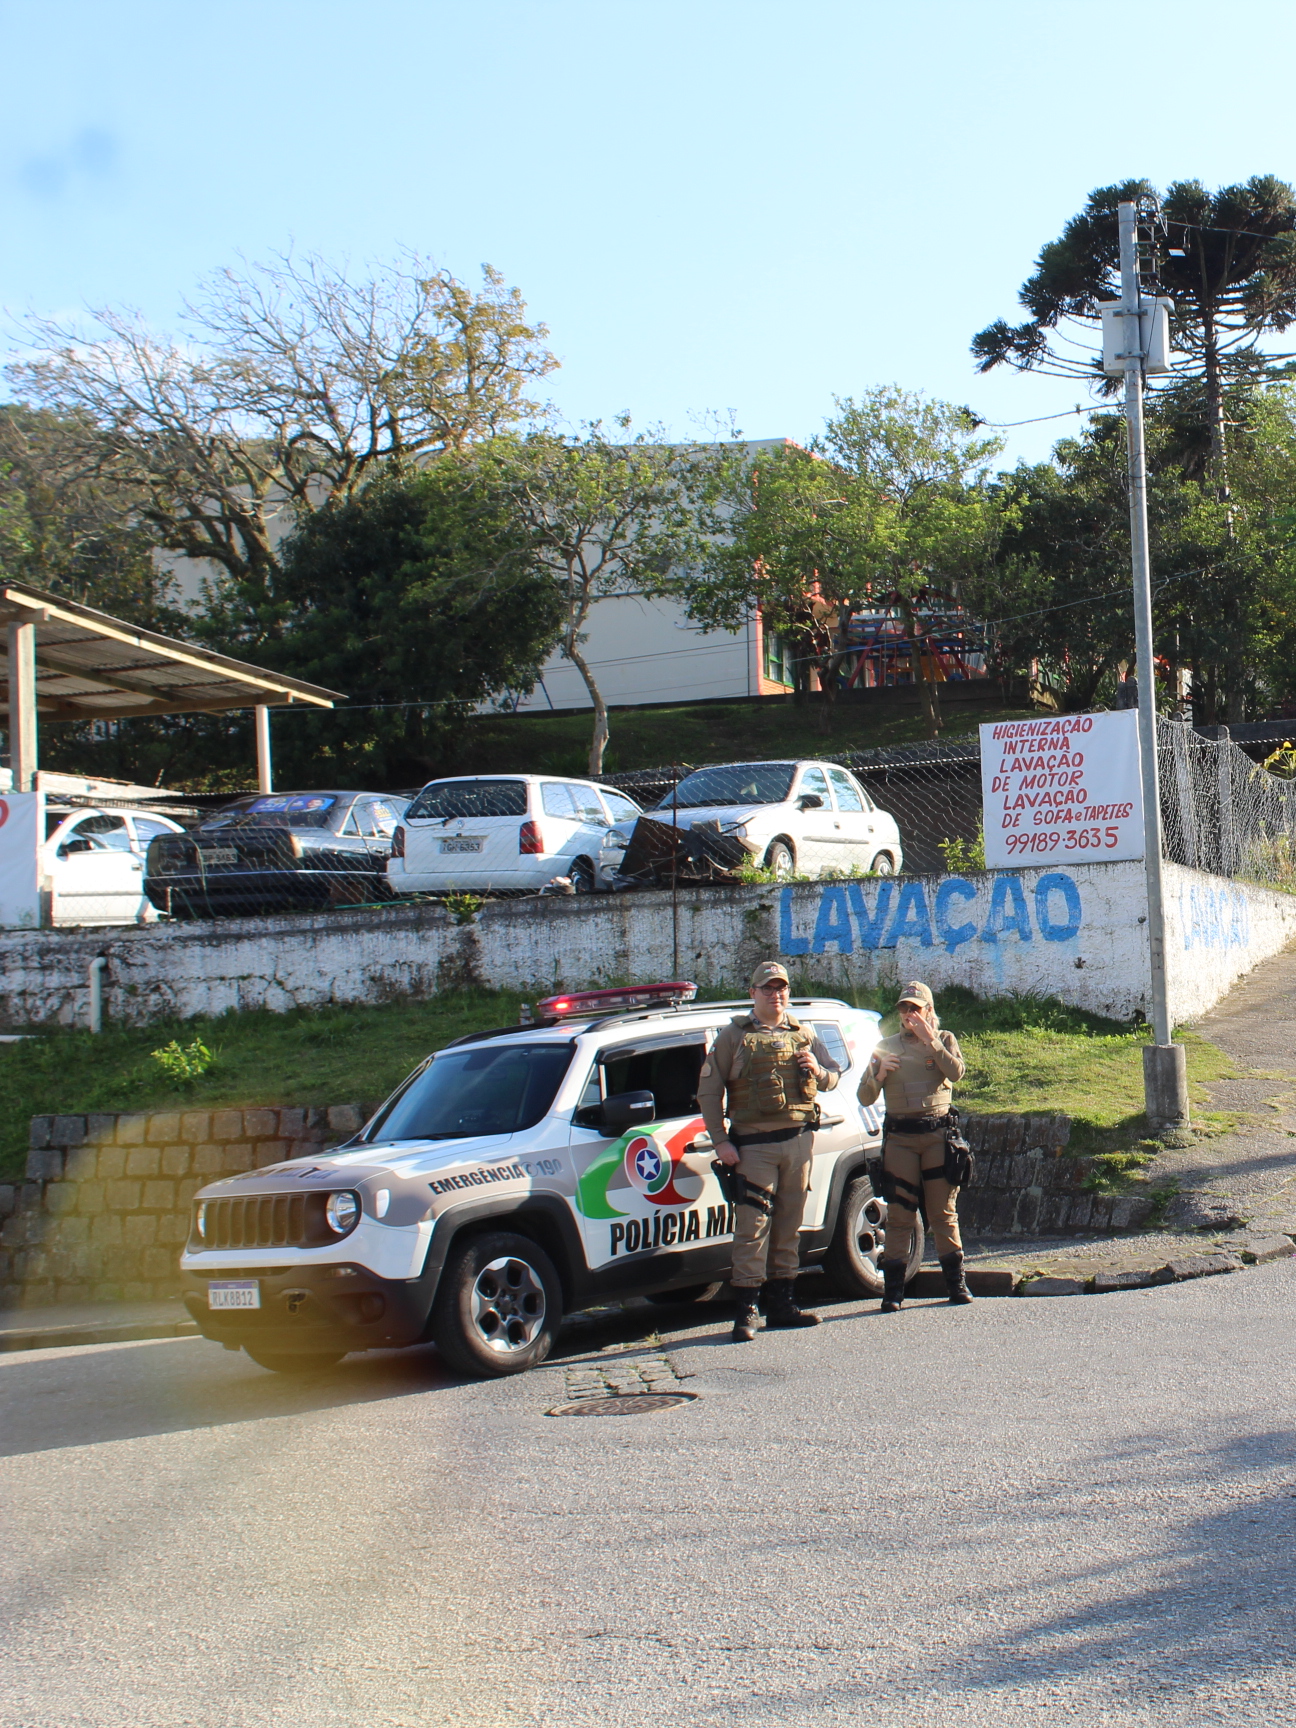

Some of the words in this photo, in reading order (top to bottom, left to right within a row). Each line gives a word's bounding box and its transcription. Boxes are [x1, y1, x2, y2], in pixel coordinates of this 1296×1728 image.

[992, 716, 1093, 740] HIGIENIZAÇÃO
[1003, 737, 1070, 755] INTERNA
[1000, 750, 1084, 773] LAVAÇÃO
[992, 776, 1011, 793] DE
[1019, 770, 1084, 791] MOTOR
[1003, 787, 1088, 810] LAVAÇÃO
[1002, 812, 1022, 828] DE
[1033, 808, 1073, 826] SOFA
[1074, 812, 1082, 821] e
[1083, 802, 1133, 821] TAPETES
[428, 1165, 526, 1195] EMERGÊNCIA
[537, 1158, 562, 1176] 190
[610, 1209, 700, 1256] POLÍCIA
